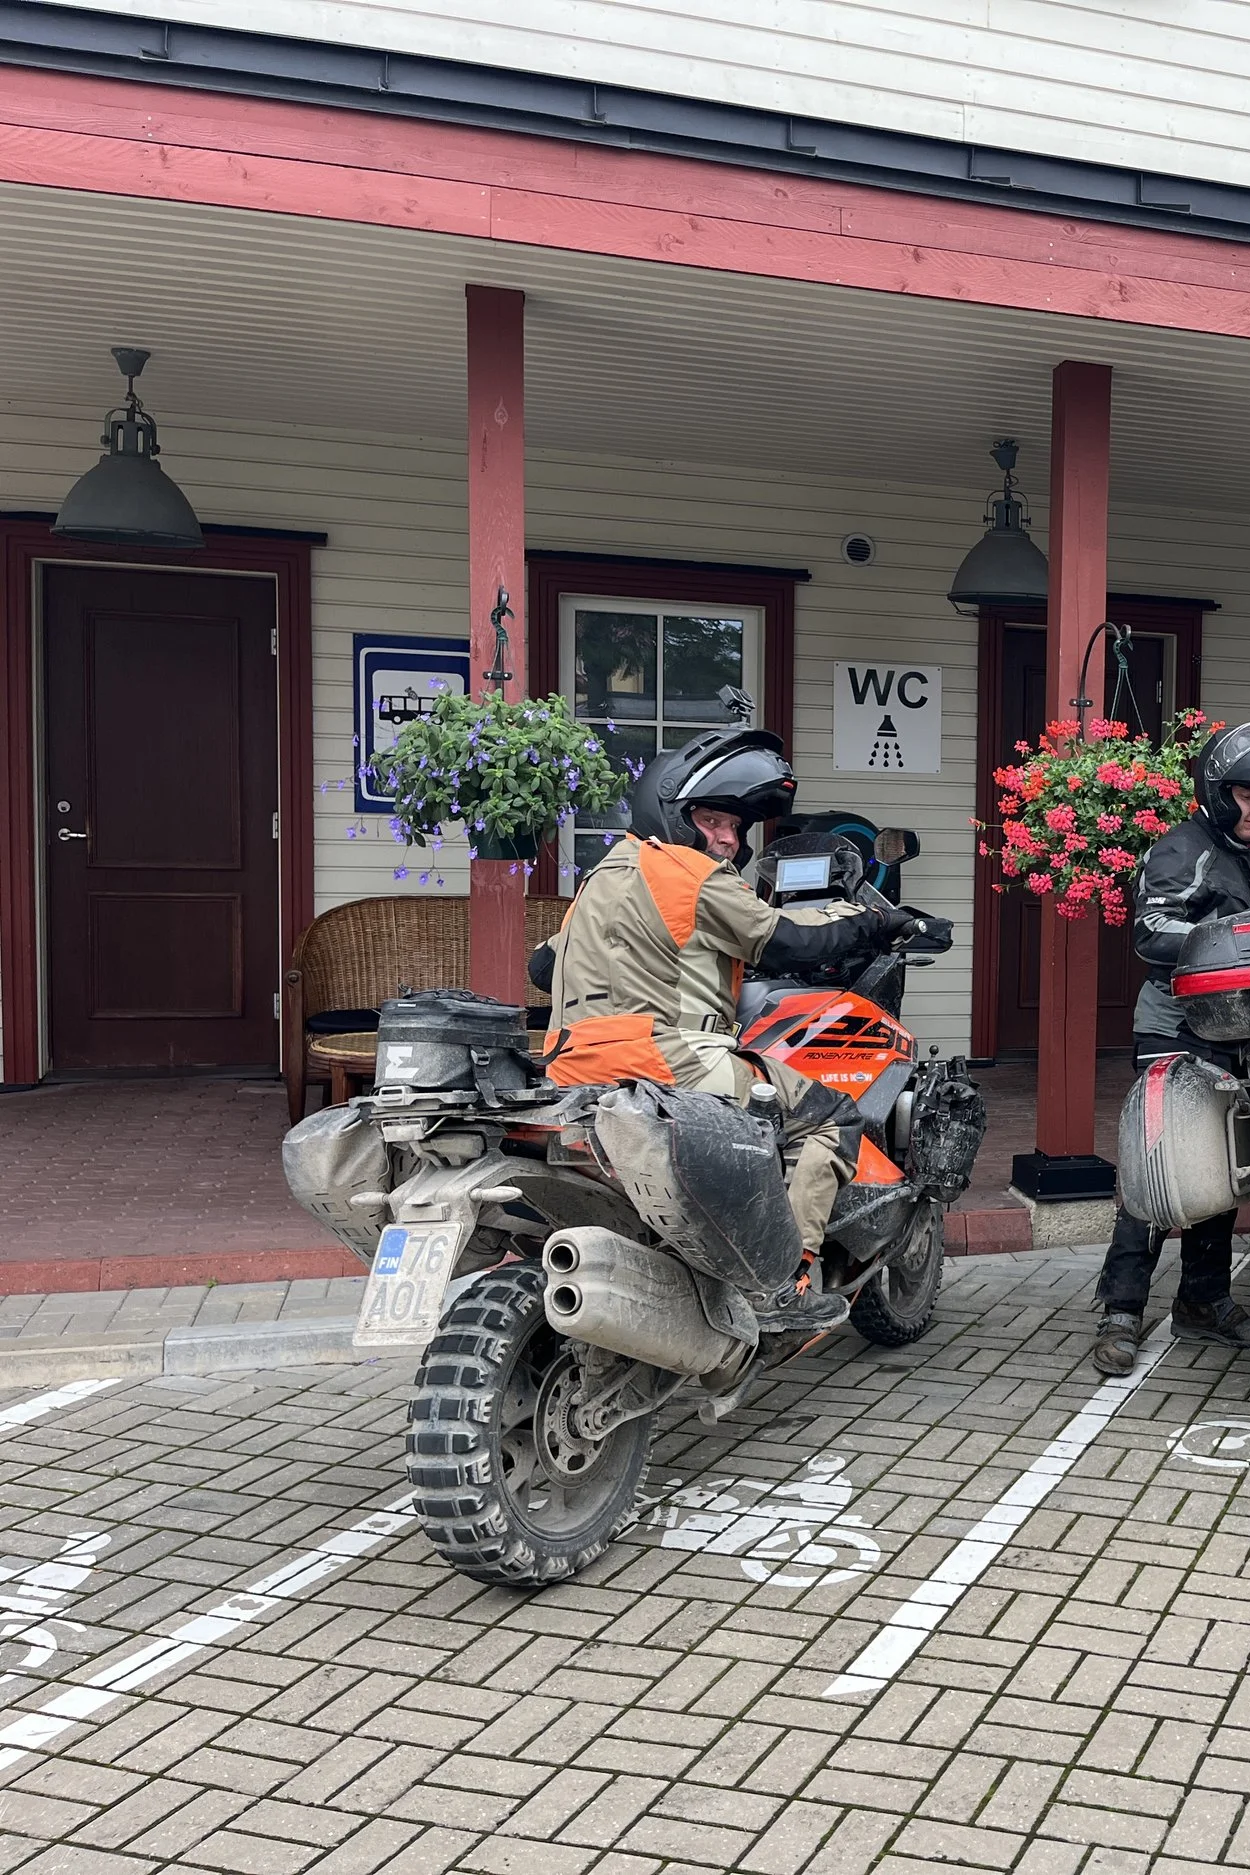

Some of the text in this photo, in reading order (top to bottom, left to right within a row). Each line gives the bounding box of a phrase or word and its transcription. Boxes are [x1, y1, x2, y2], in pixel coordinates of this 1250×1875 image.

[848, 667, 928, 709] WC
[803, 1052, 874, 1061] ADVENTURE
[821, 1073, 840, 1083] LIFE
[840, 1073, 848, 1082] IS
[379, 1234, 448, 1275] FIN 76
[368, 1280, 430, 1320] AOL
